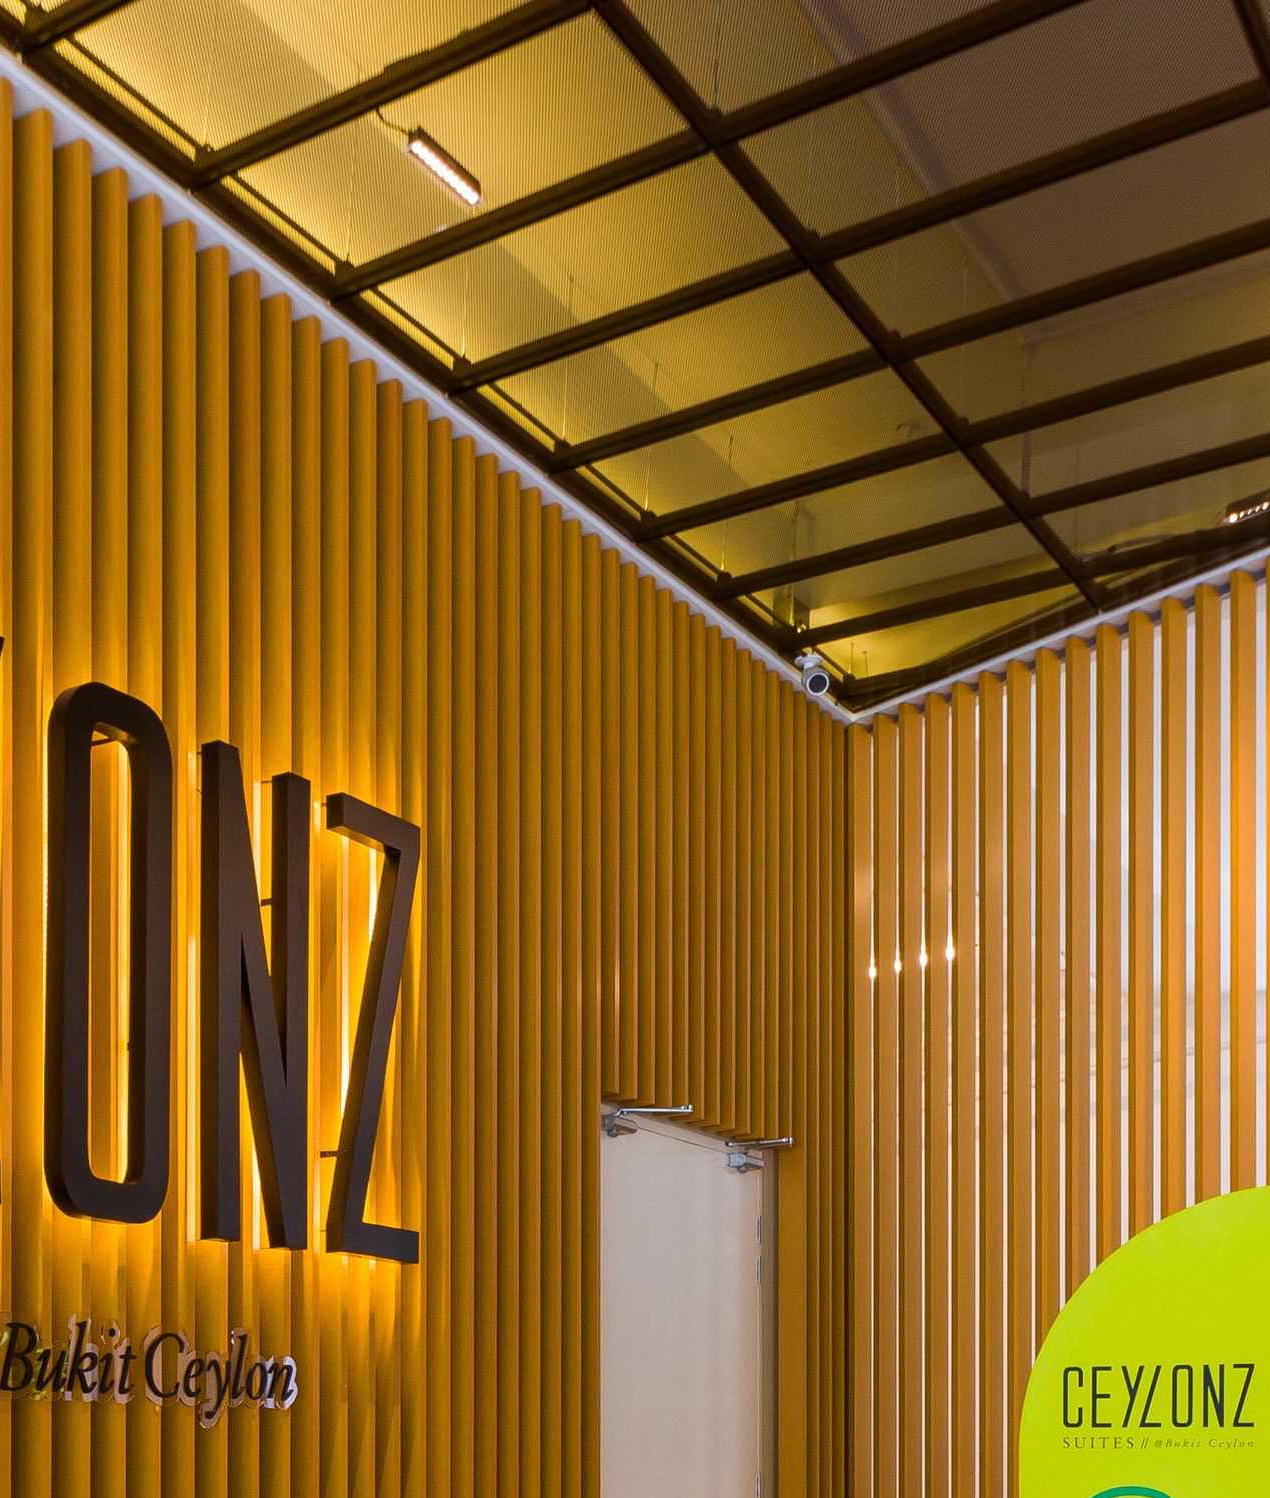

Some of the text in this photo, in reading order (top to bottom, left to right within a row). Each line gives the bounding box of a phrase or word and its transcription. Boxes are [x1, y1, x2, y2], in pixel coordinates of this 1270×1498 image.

[144, 1332, 295, 1420] Ceylon
[1061, 1363, 1255, 1429] CEYLONZ
[1062, 1436, 1135, 1450] SUITES
[1208, 1438, 1255, 1451] Ceylon
